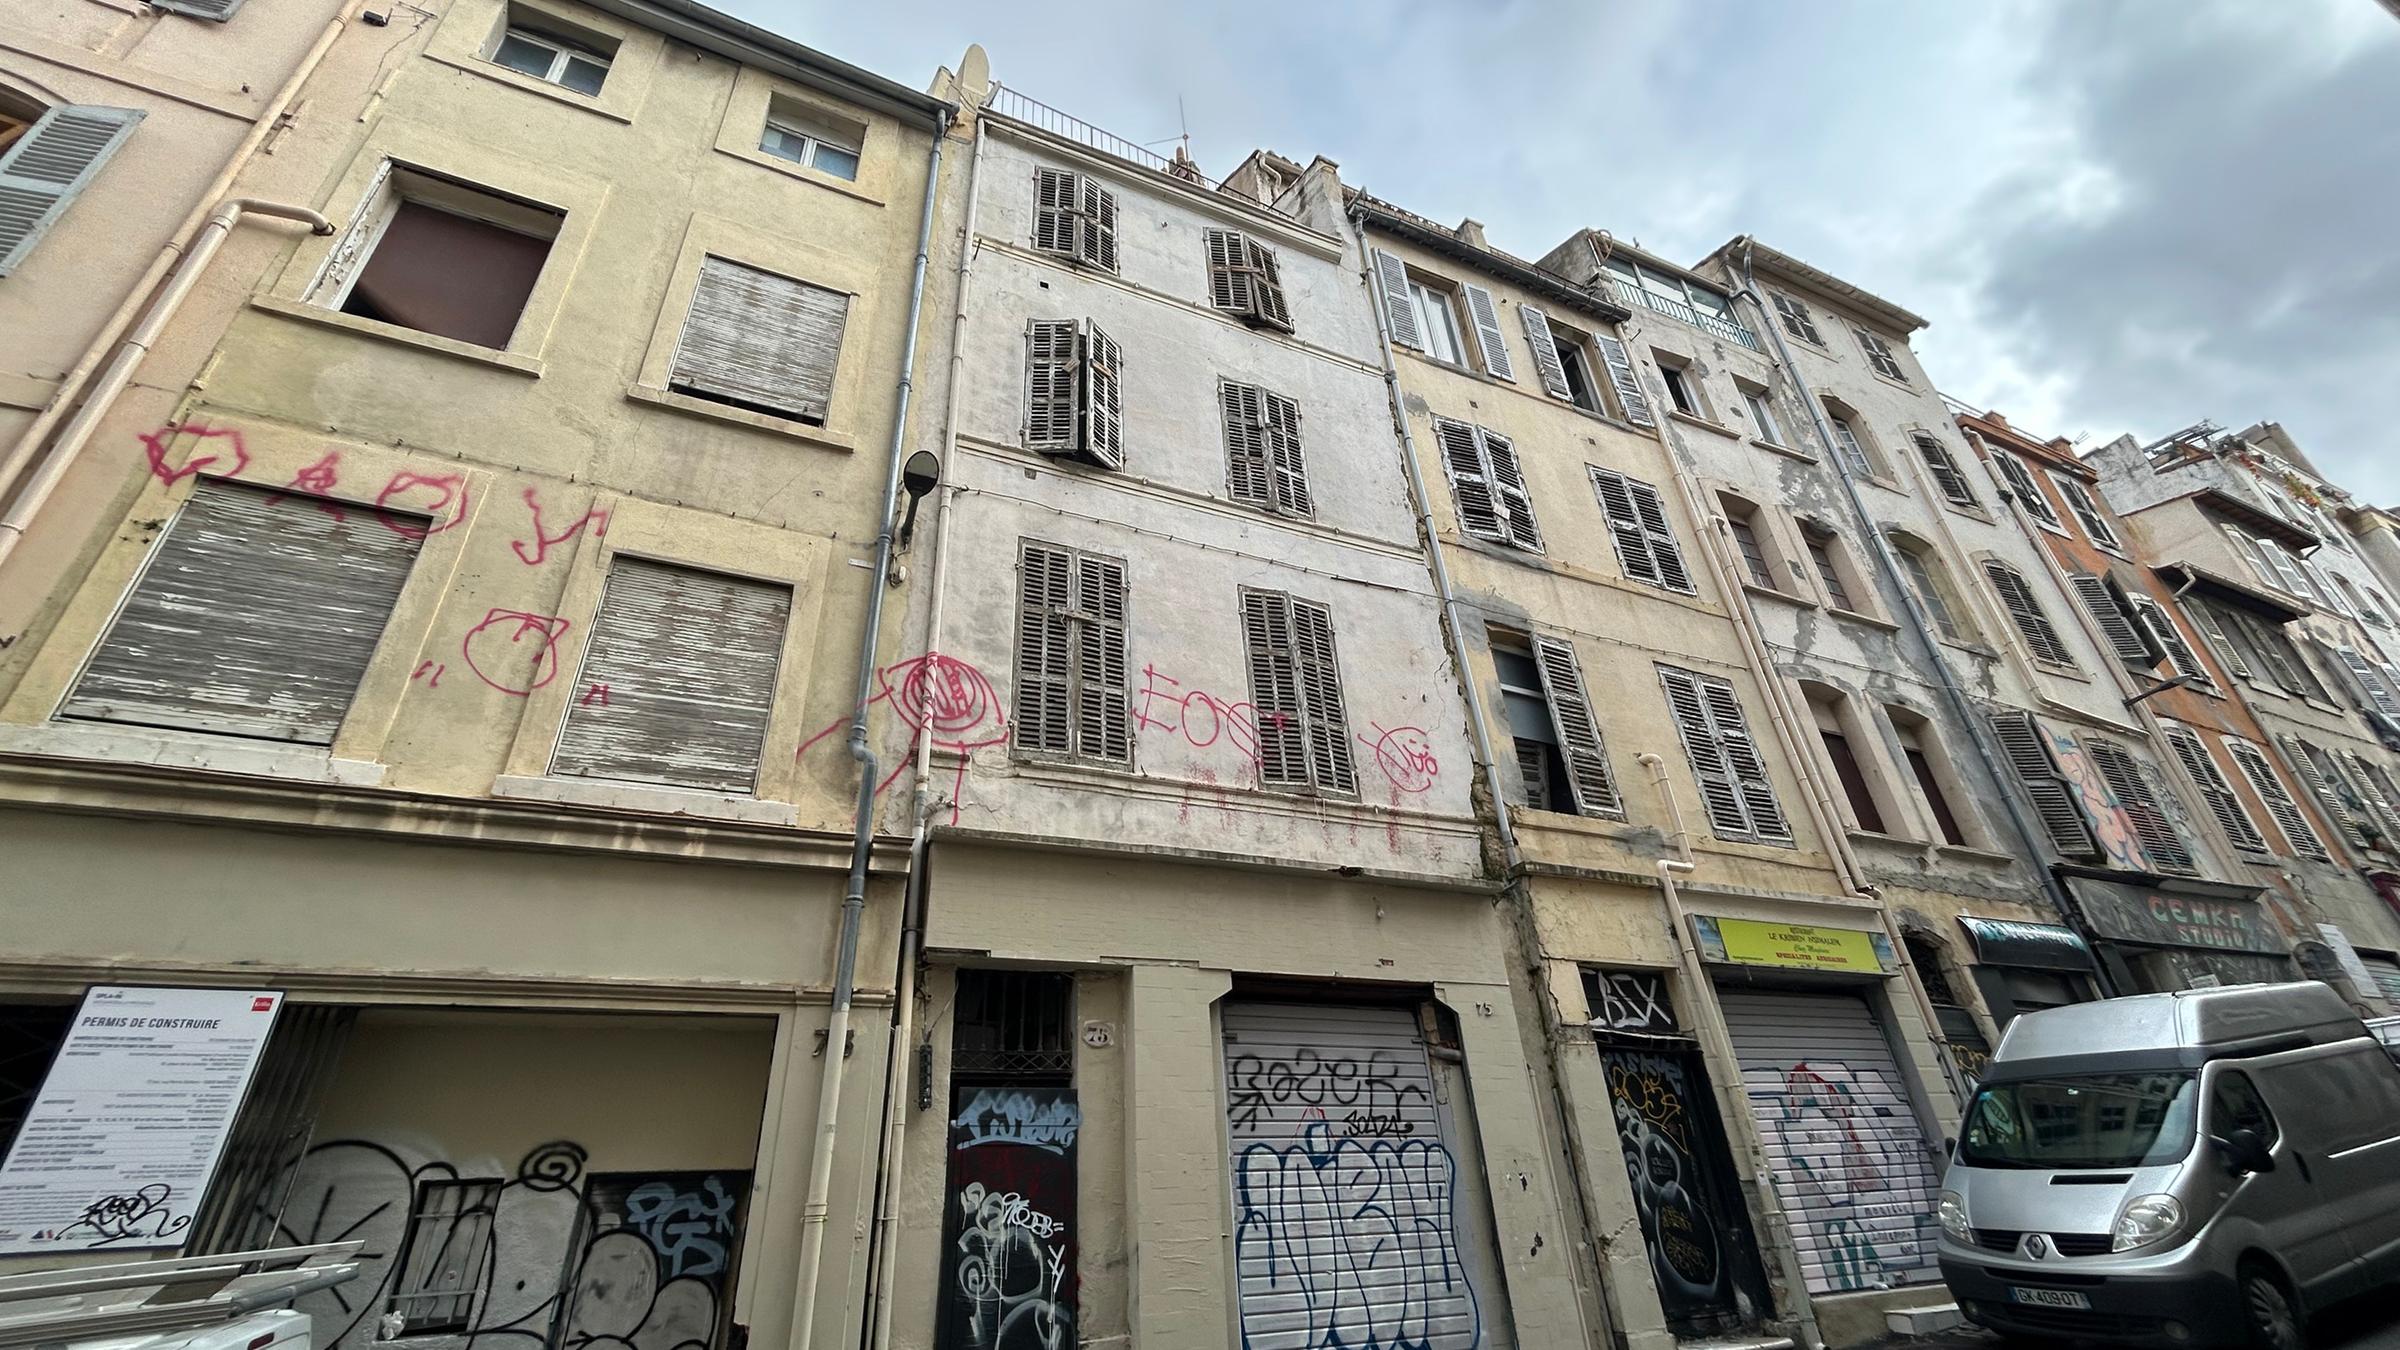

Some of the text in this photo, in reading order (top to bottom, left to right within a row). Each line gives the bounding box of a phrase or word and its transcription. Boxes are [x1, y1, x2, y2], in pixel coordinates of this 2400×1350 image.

[1475, 1001, 1493, 1017] 75
[81, 1016, 221, 1030] PERMIS DE CONSTRUIRE
